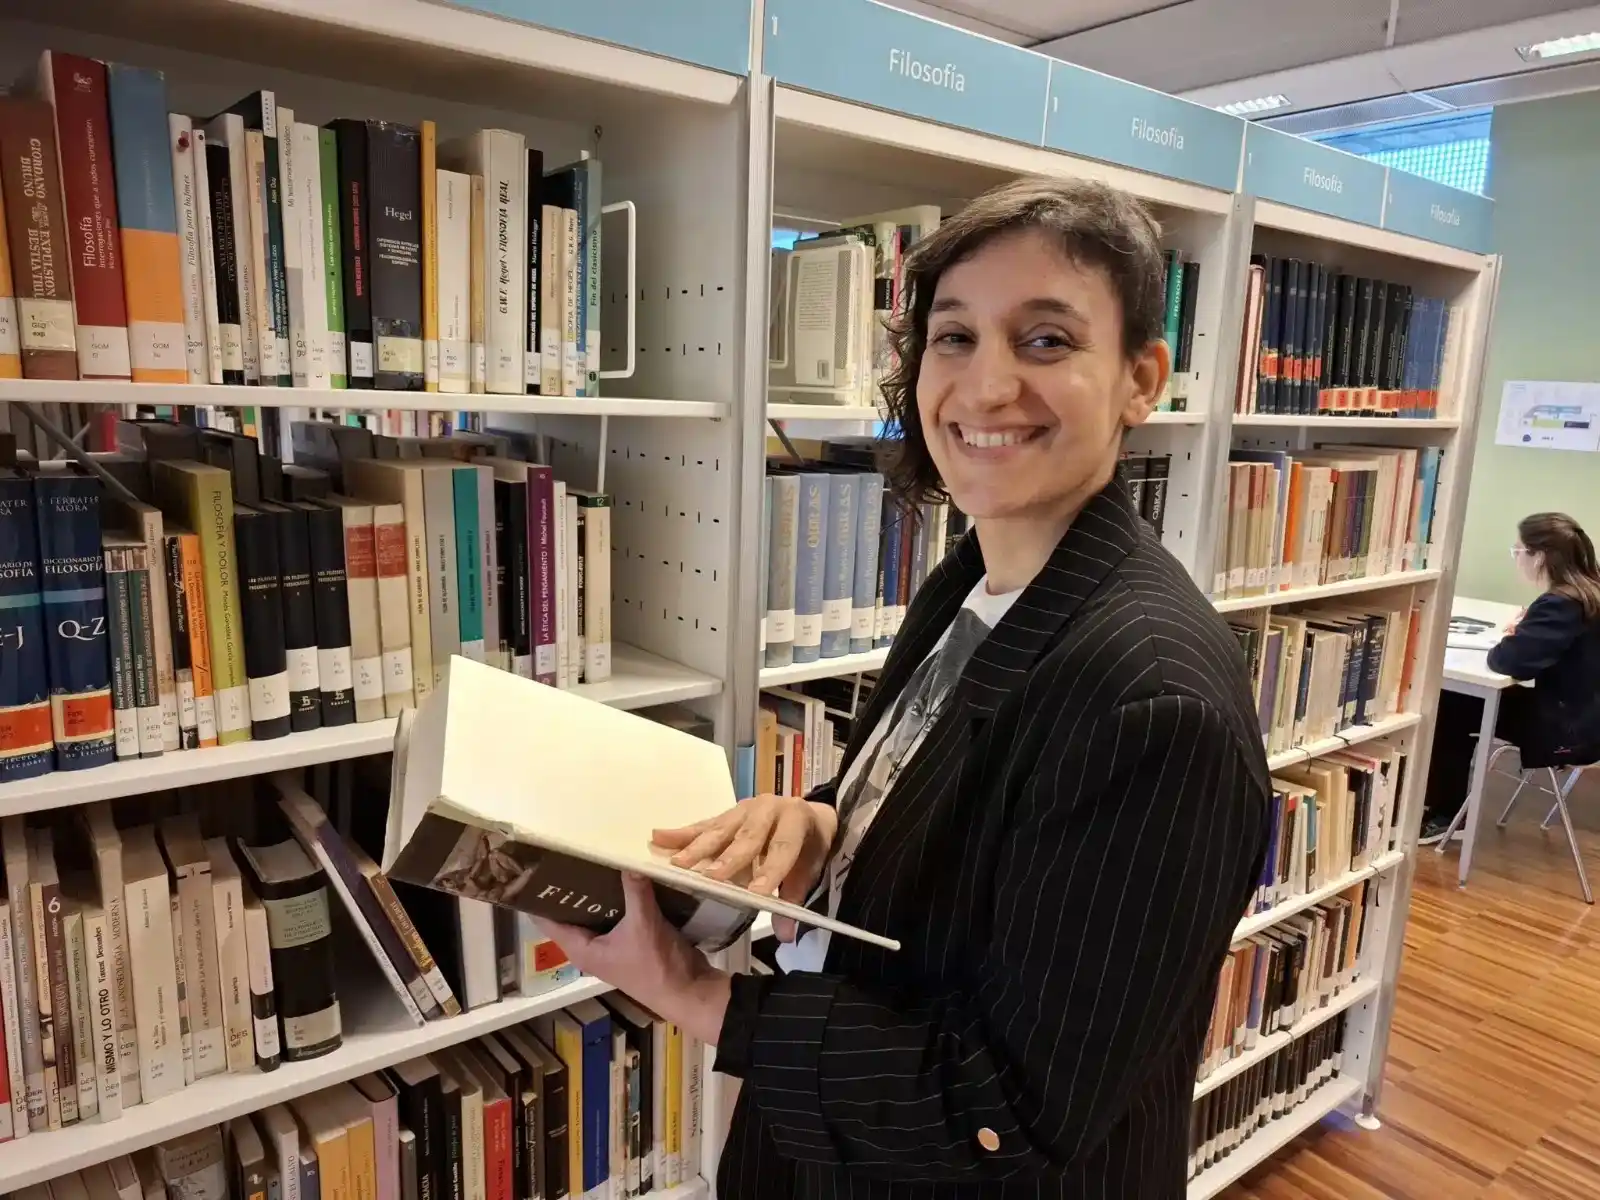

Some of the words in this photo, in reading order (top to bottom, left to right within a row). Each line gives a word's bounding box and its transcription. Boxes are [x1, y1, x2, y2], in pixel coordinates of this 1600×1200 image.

[889, 48, 965, 93] Filosofía
[1130, 116, 1185, 151] Filosofía
[20, 156, 35, 197] BRUNO
[1303, 167, 1344, 194] Filosofía
[384, 205, 413, 222] Hegel
[1430, 203, 1461, 227] Filosofía
[80, 216, 97, 268] Filosofía
[589, 229, 598, 275] clasicismo
[499, 259, 510, 285] Hegel
[589, 277, 597, 290] del
[589, 293, 597, 307] Fin
[0, 498, 28, 508] ATER
[49, 495, 100, 505] FERRATER
[55, 504, 89, 512] MORA
[211, 490, 226, 541] FILOSOFÍA
[43, 556, 96, 565] DICCIONARIO
[217, 550, 229, 588] DOLOR
[541, 599, 549, 612] DEL
[58, 616, 106, 642] Q-Z
[542, 632, 549, 641] LA
[536, 882, 620, 921] Filos
[98, 960, 106, 983] Vincent
[98, 988, 111, 1016] OTRO
[101, 1017, 112, 1031] LO
[103, 1043, 117, 1074] MISMO
